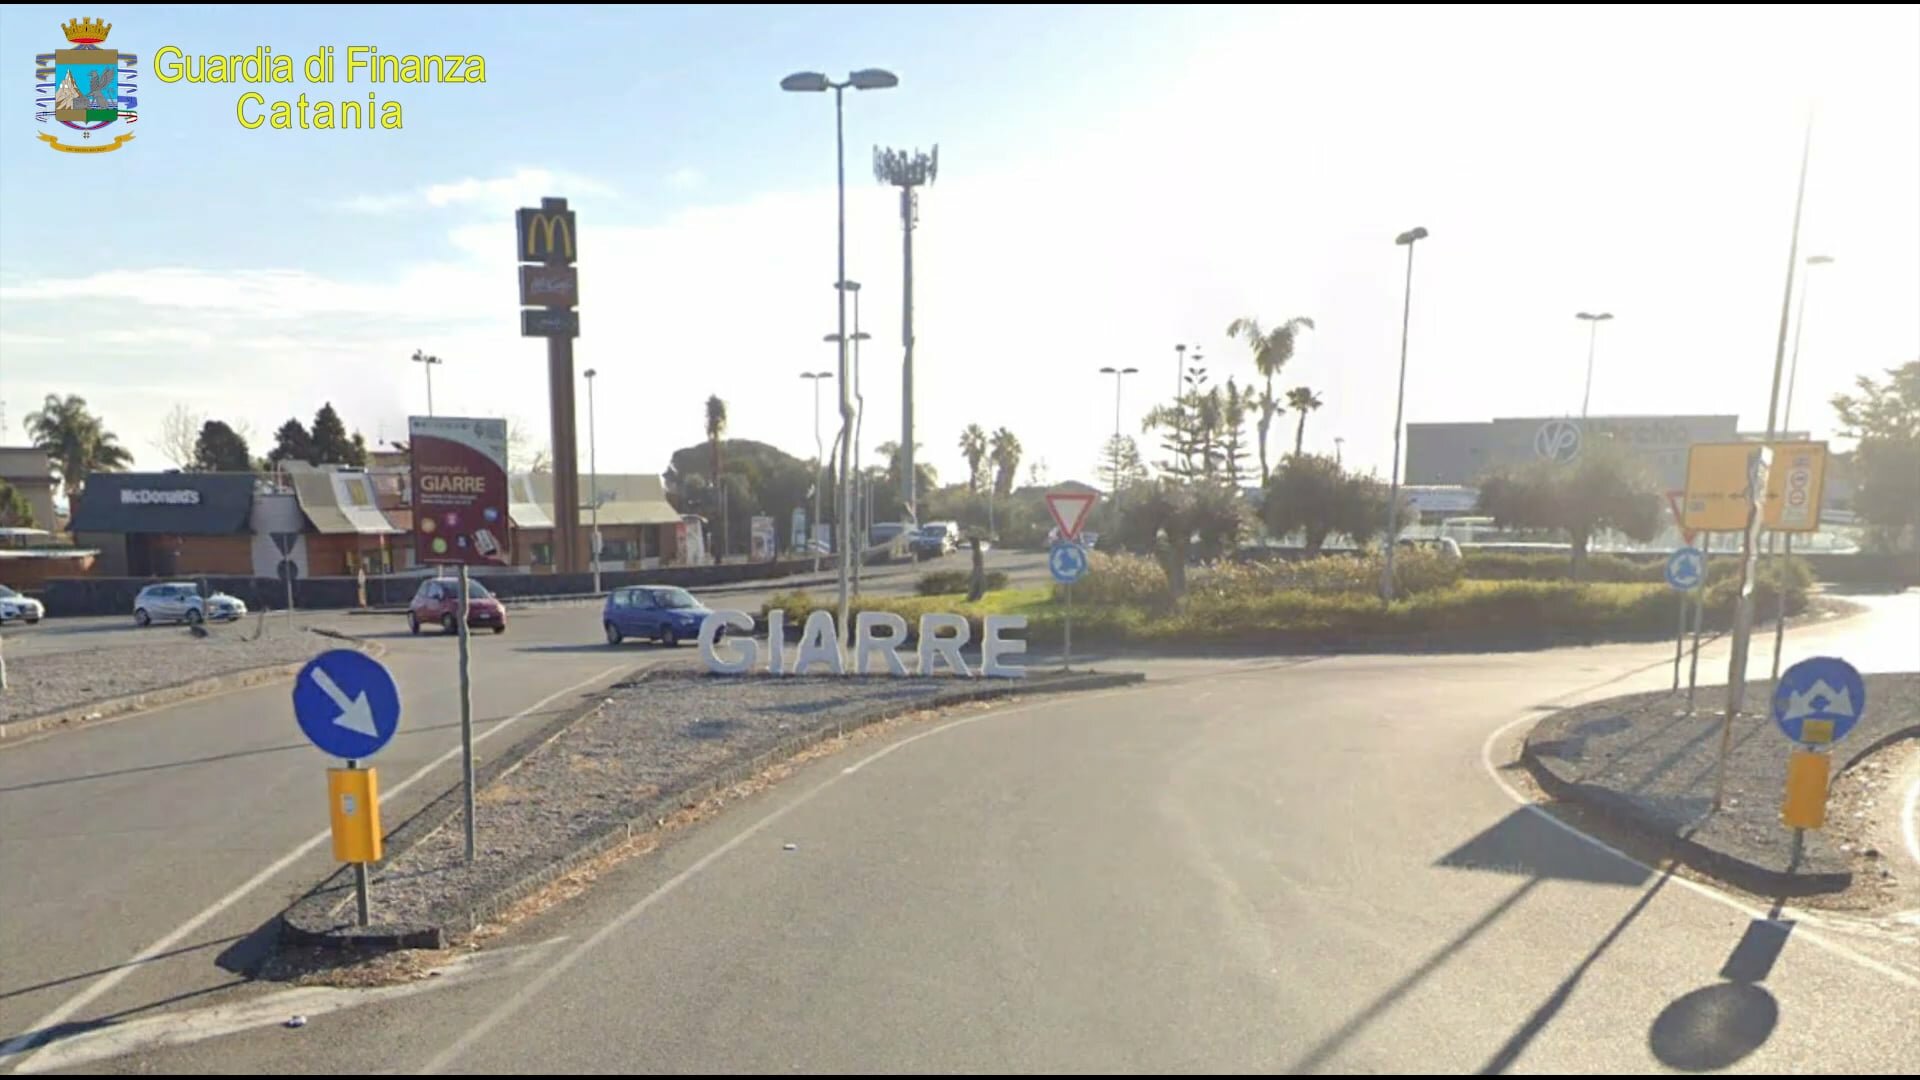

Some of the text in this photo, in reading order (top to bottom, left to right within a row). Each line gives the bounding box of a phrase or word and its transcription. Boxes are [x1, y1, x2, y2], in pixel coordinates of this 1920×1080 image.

[420, 474, 486, 493] GIARRE
[121, 489, 200, 504] McDonald's
[698, 608, 1028, 678] GIARRE
